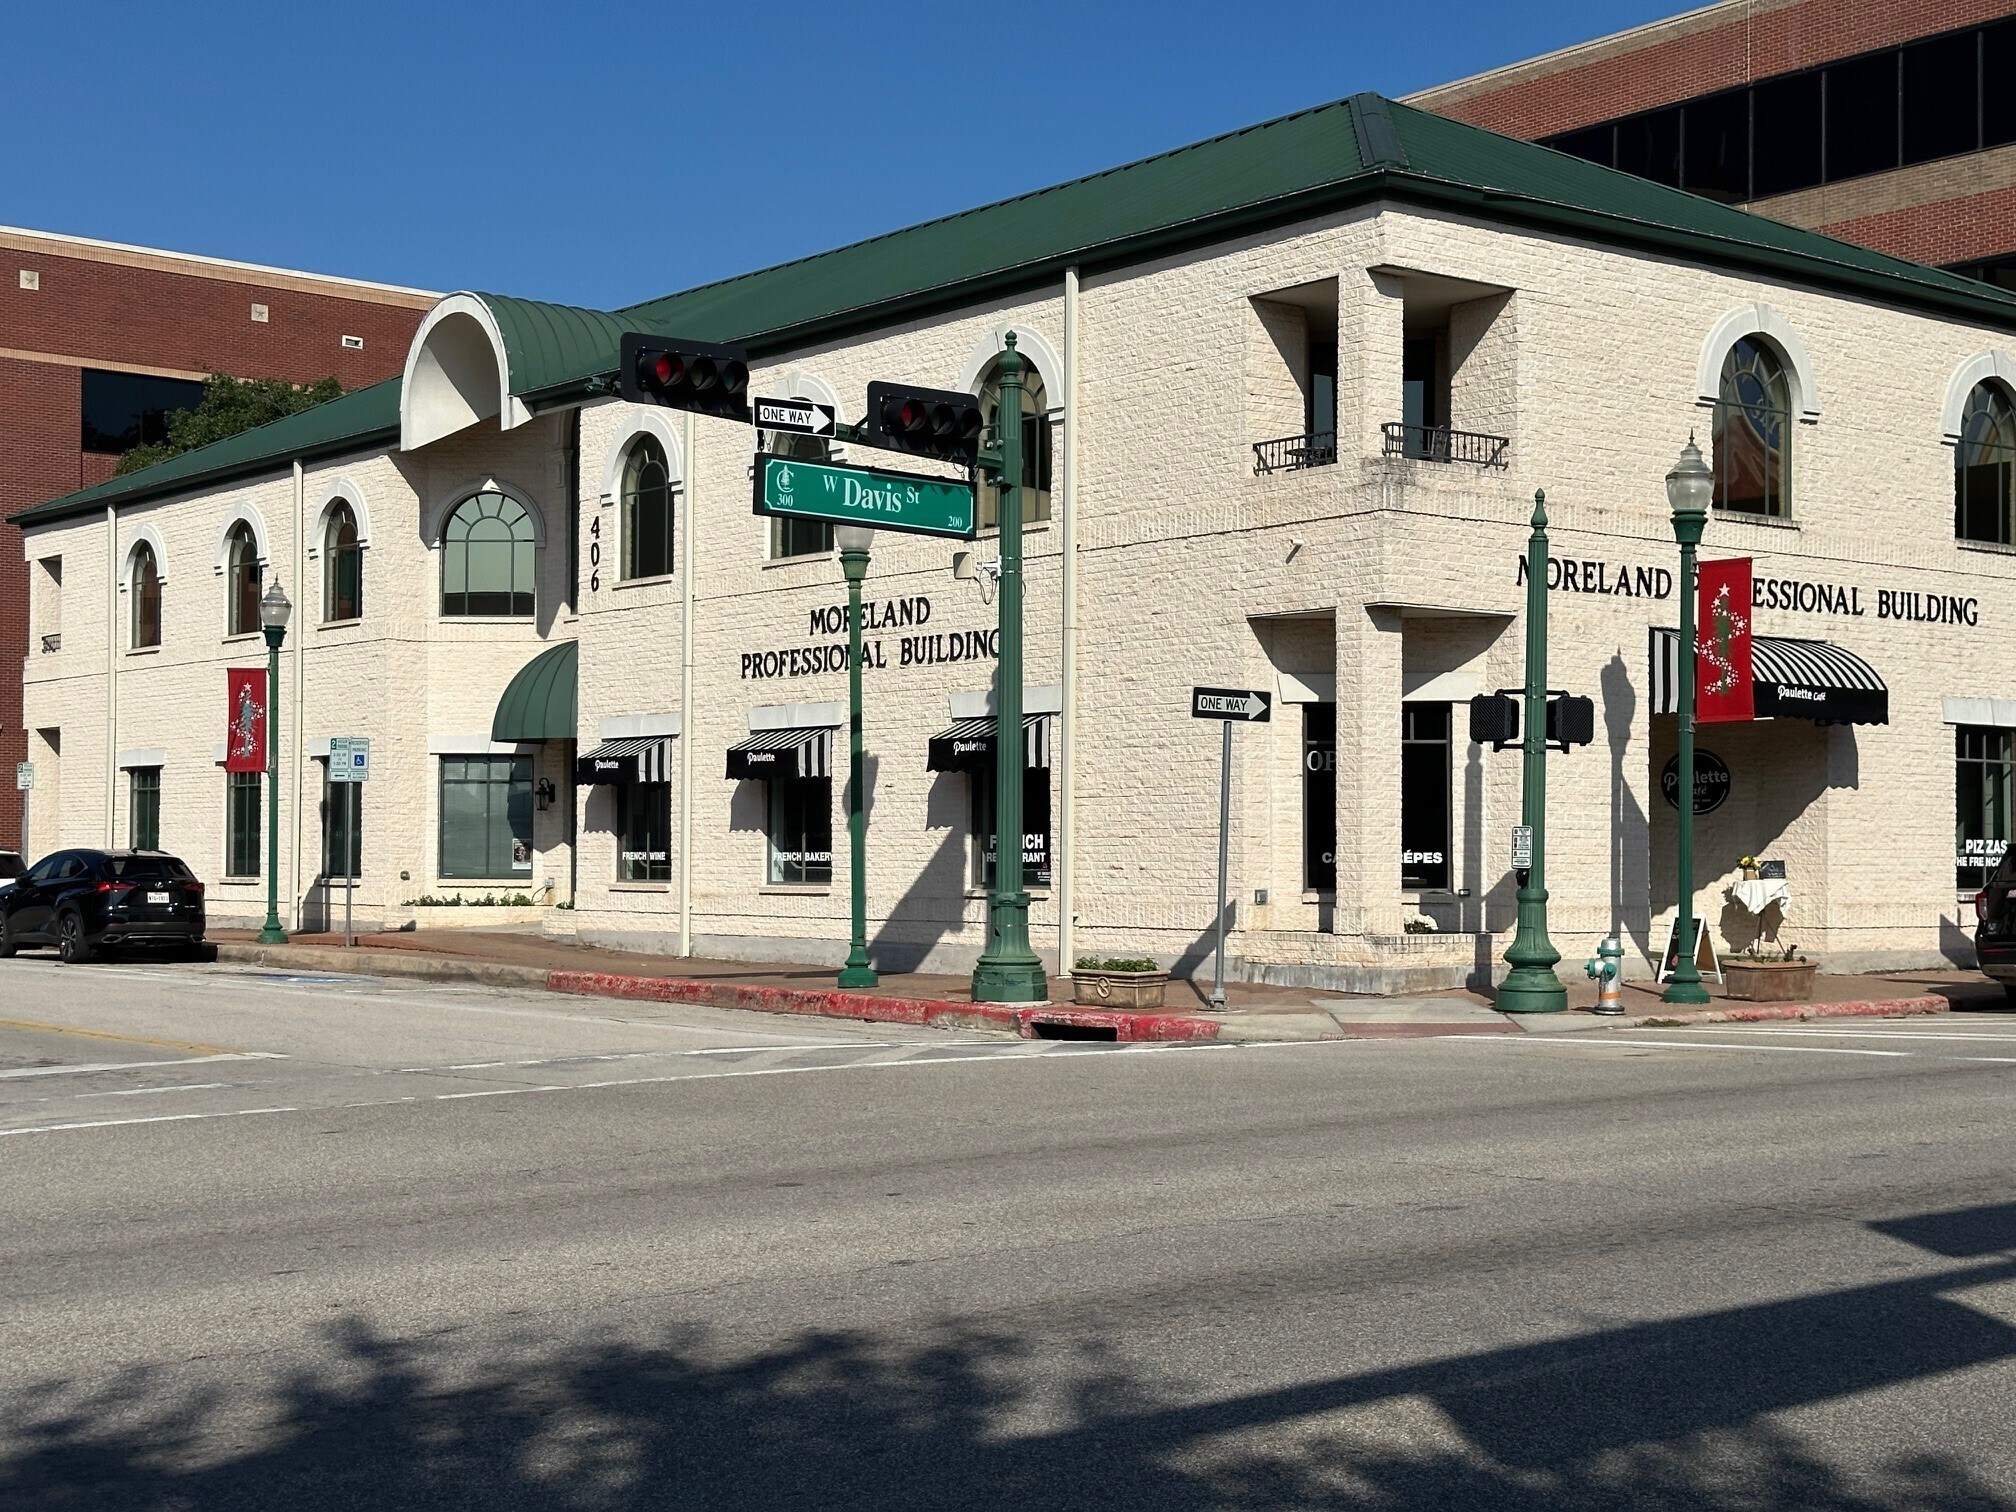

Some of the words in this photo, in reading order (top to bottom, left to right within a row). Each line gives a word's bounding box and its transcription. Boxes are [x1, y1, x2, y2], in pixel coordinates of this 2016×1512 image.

[762, 407, 785, 422] ONE
[788, 409, 812, 425] WAY
[777, 493, 794, 507] 300
[823, 474, 838, 493] W
[843, 477, 901, 512] Davis
[906, 486, 920, 504] St
[948, 515, 963, 528] 200
[1877, 589, 1979, 626] BUILDING
[1778, 685, 1812, 701] Paulette
[1200, 696, 1222, 710] ONE
[1226, 698, 1248, 711] WAY
[331, 740, 336, 749] 2
[953, 740, 987, 756] Paulette
[595, 759, 619, 772] Paulette
[746, 752, 775, 765] Paulette
[1663, 771, 1728, 791] Plette
[622, 851, 647, 861] FRENCH
[649, 851, 666, 860] WINE
[773, 851, 802, 861] FRENCH
[804, 852, 833, 861] BAKERY
